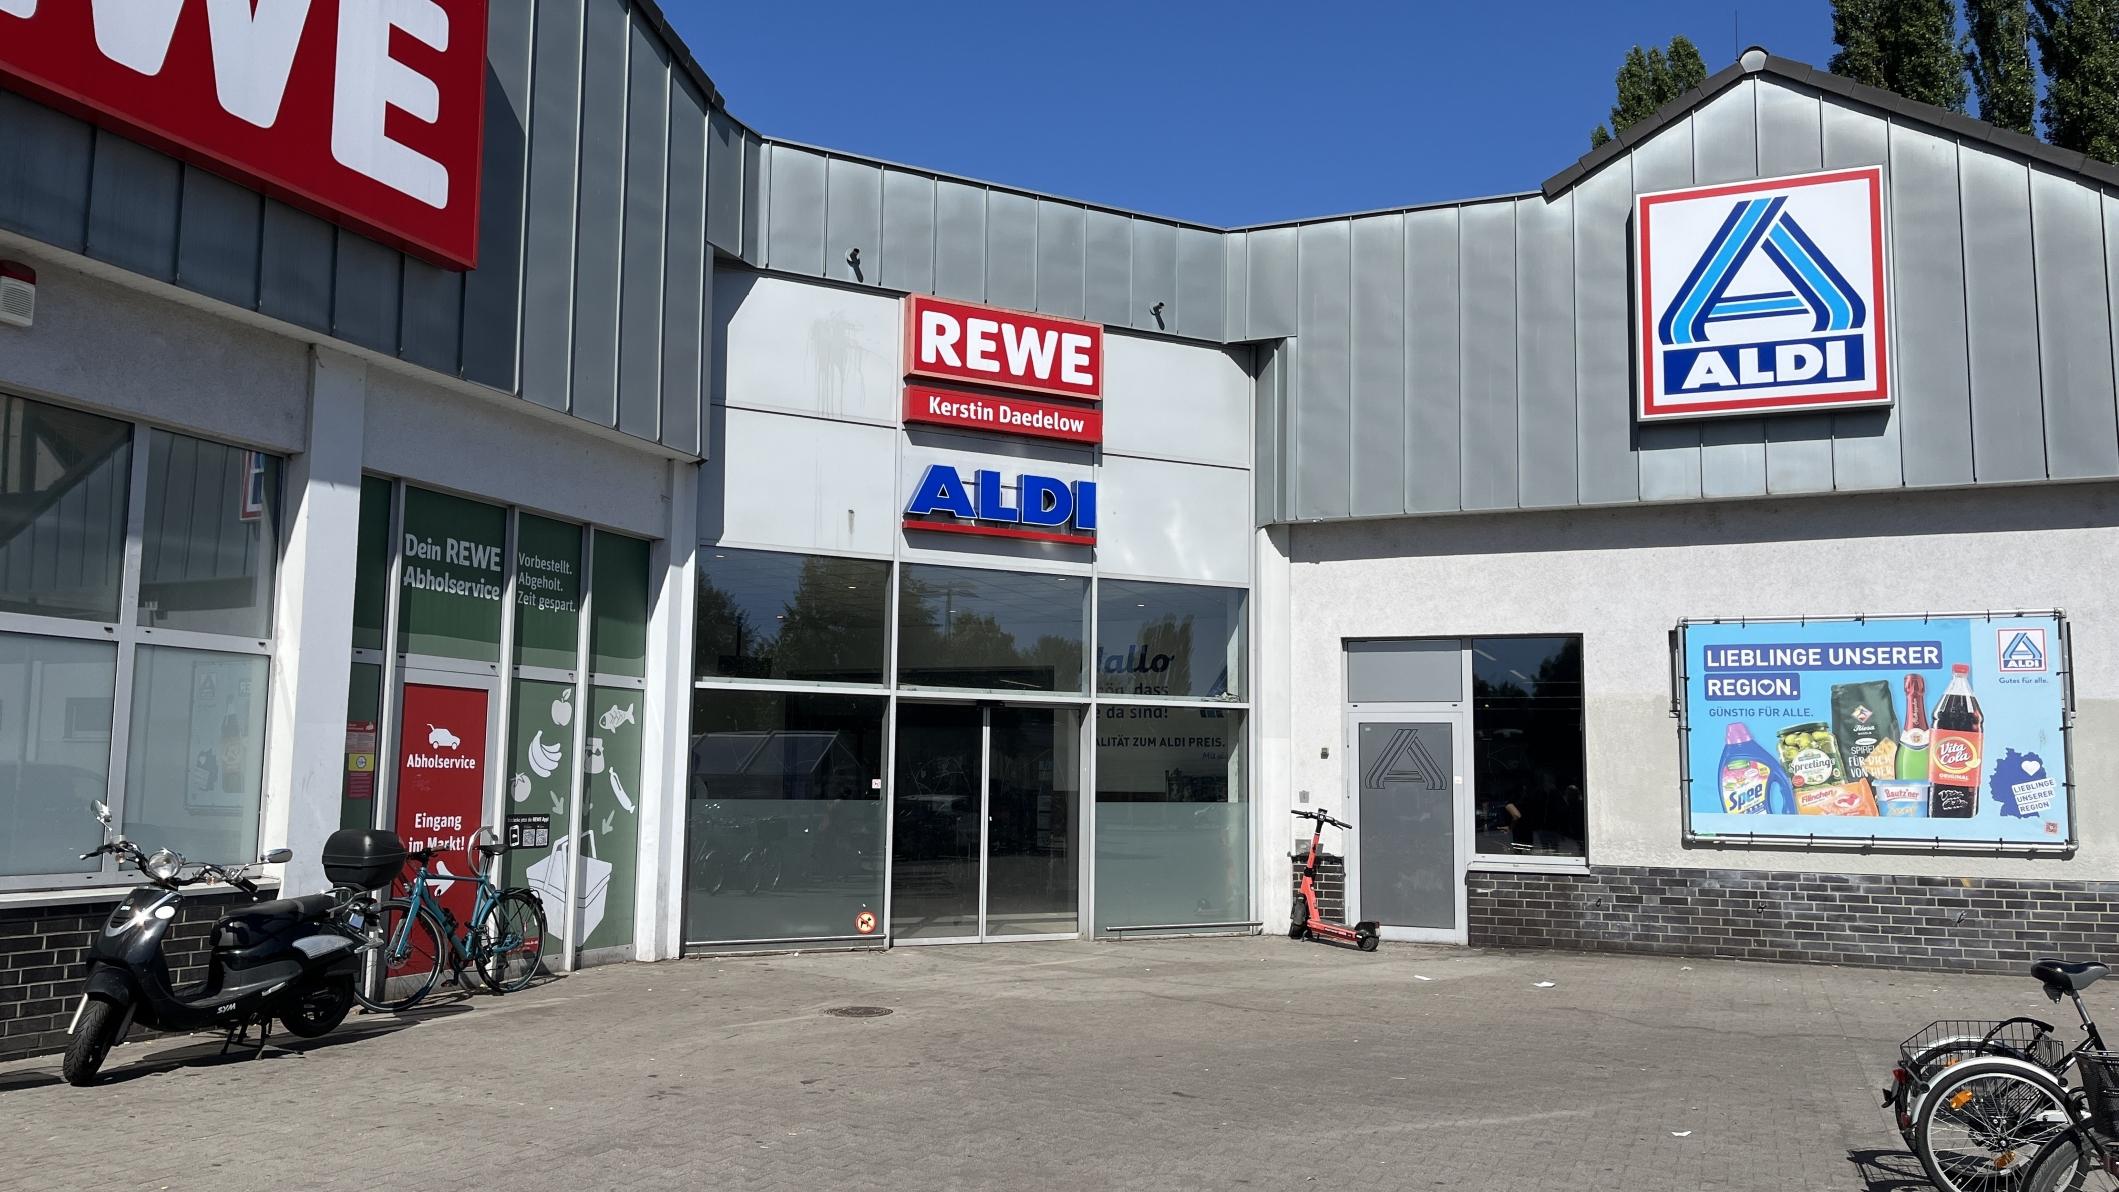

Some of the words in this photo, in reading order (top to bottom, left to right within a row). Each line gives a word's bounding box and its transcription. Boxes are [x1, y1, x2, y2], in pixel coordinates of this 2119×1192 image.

[921, 310, 1094, 386] REWE
[1681, 340, 1847, 390] ALDI
[929, 396, 994, 422] Kerstin
[999, 405, 1085, 433] Daedelow
[904, 464, 1097, 530] ALDI
[404, 533, 442, 561] Dein
[446, 538, 501, 571] REWE
[519, 552, 573, 575] Vorbestellt.
[403, 565, 500, 600] Abholservice
[518, 571, 564, 592] Abgeholt.
[518, 591, 537, 606] Zeit
[538, 597, 576, 613] gespart.
[1706, 648, 1821, 667] LIEBLINGE
[1829, 646, 1939, 665] UNSERER
[2007, 660, 2040, 668] ALDI
[1708, 678, 1798, 697] REGION.
[1107, 706, 1124, 719] da
[1709, 706, 1755, 717] GÜNSTIG
[1759, 706, 1780, 717] FÜR
[1782, 708, 1814, 717] ALLE.
[1133, 737, 1156, 748] ZUM
[1160, 737, 1185, 747] ALDI
[1189, 737, 1225, 748] PREIS.
[1940, 742, 1967, 755] Vita
[406, 754, 476, 769] Abholservice
[1941, 751, 1970, 765] Cola
[2013, 779, 2055, 793] LIEBLINGE
[1729, 783, 1763, 811] Spee
[2016, 790, 2054, 803] UNSERER
[2019, 801, 2050, 813] REGION
[414, 812, 462, 831] Eingang
[408, 837, 424, 853] im
[216, 1003, 236, 1014] SYM
